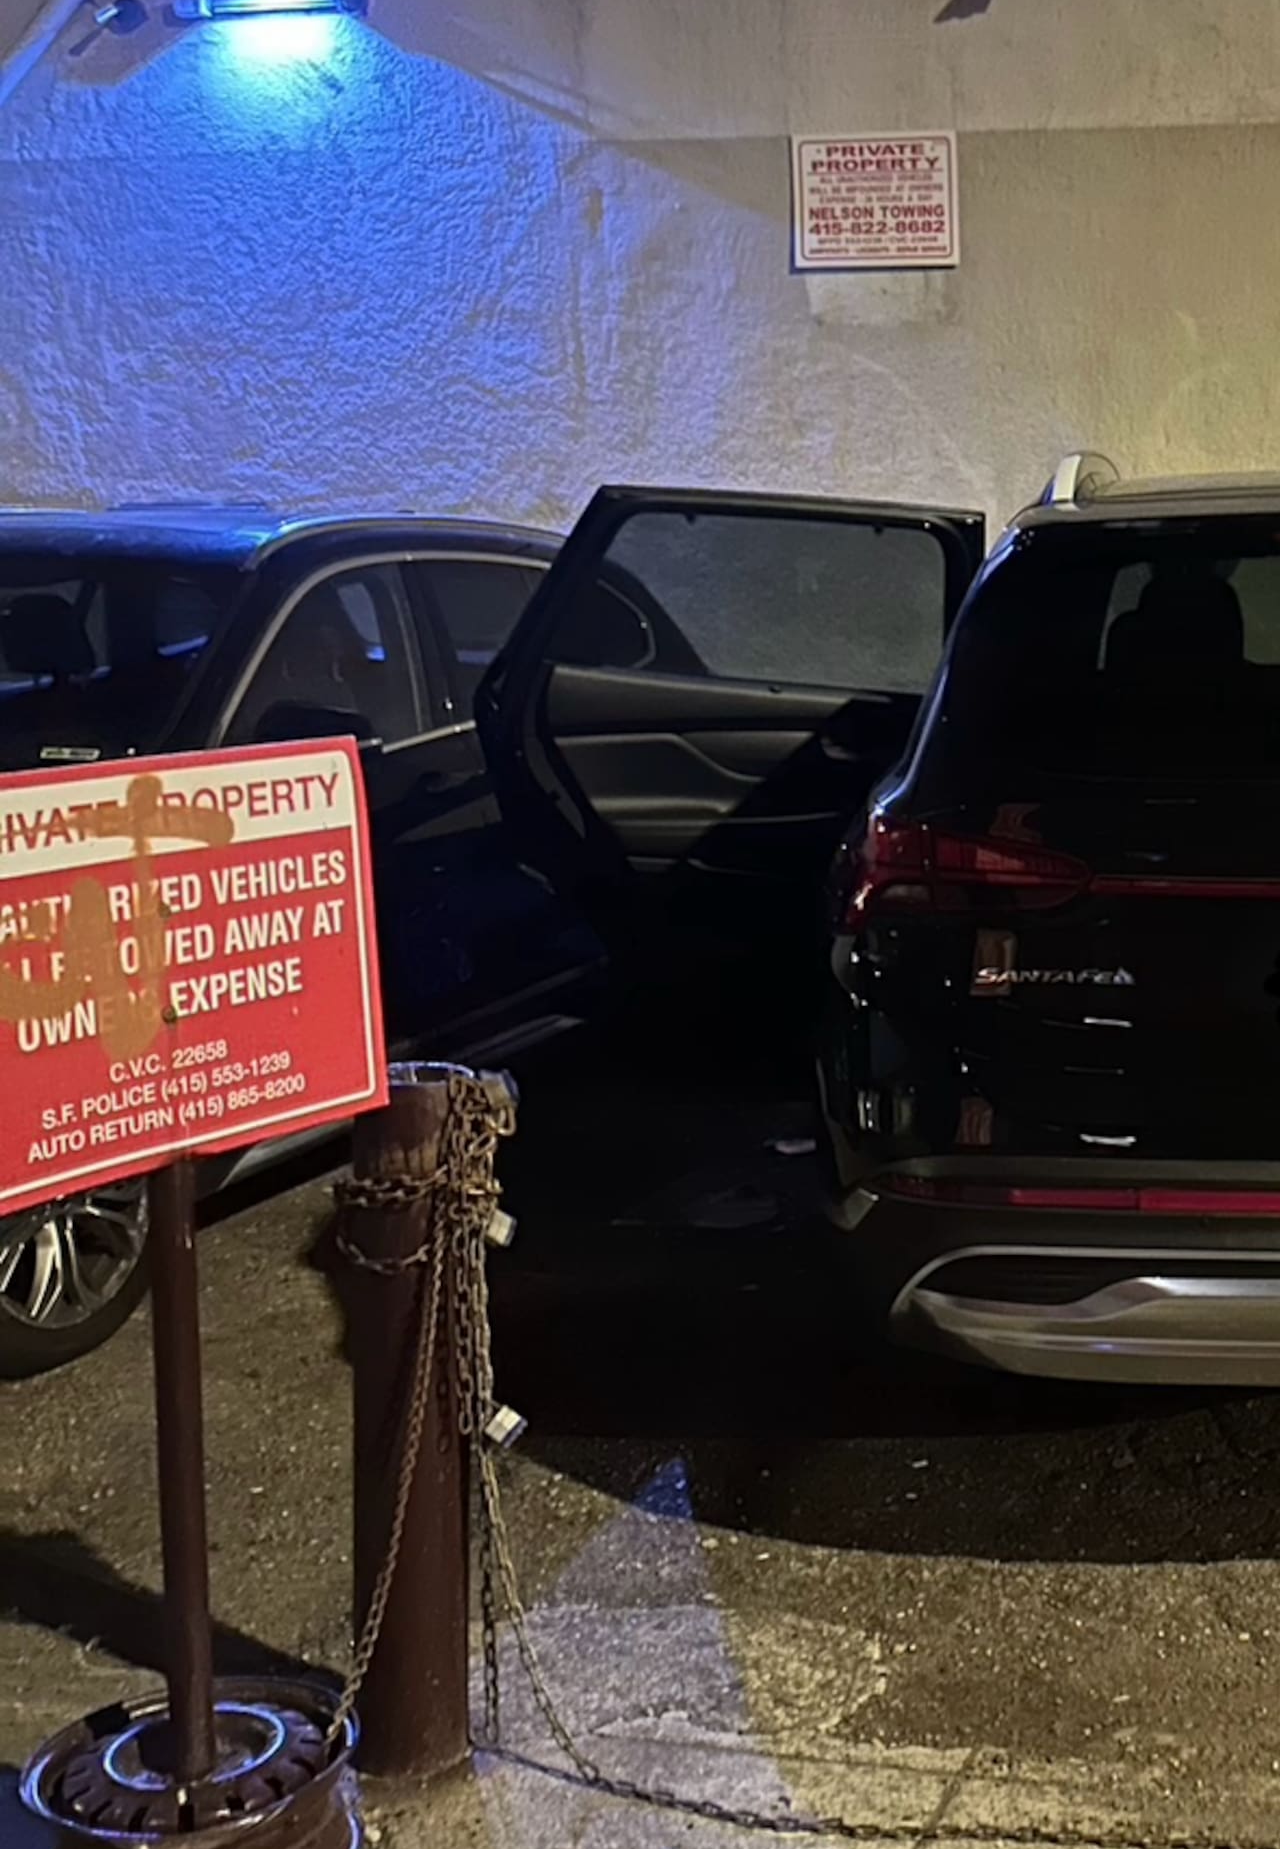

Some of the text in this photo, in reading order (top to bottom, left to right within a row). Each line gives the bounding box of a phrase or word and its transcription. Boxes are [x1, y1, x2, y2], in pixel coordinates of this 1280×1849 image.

[811, 156, 940, 172] PROPERTY
[825, 143, 925, 157] PRIVATE
[809, 204, 945, 220] NELSON TOWING
[0, 772, 339, 852] IVAT ROPERTY
[211, 849, 347, 904] VEHICLES
[224, 906, 304, 955] AWAY
[313, 899, 345, 937] AT
[170, 957, 303, 1018] EXPENSE
[109, 1038, 228, 1084] C.V.C. 22658
[42, 1050, 291, 1130] S.F. POLICE (415) 553-1239
[27, 1073, 306, 1164] AUTO RETURN (415) 865-8200
